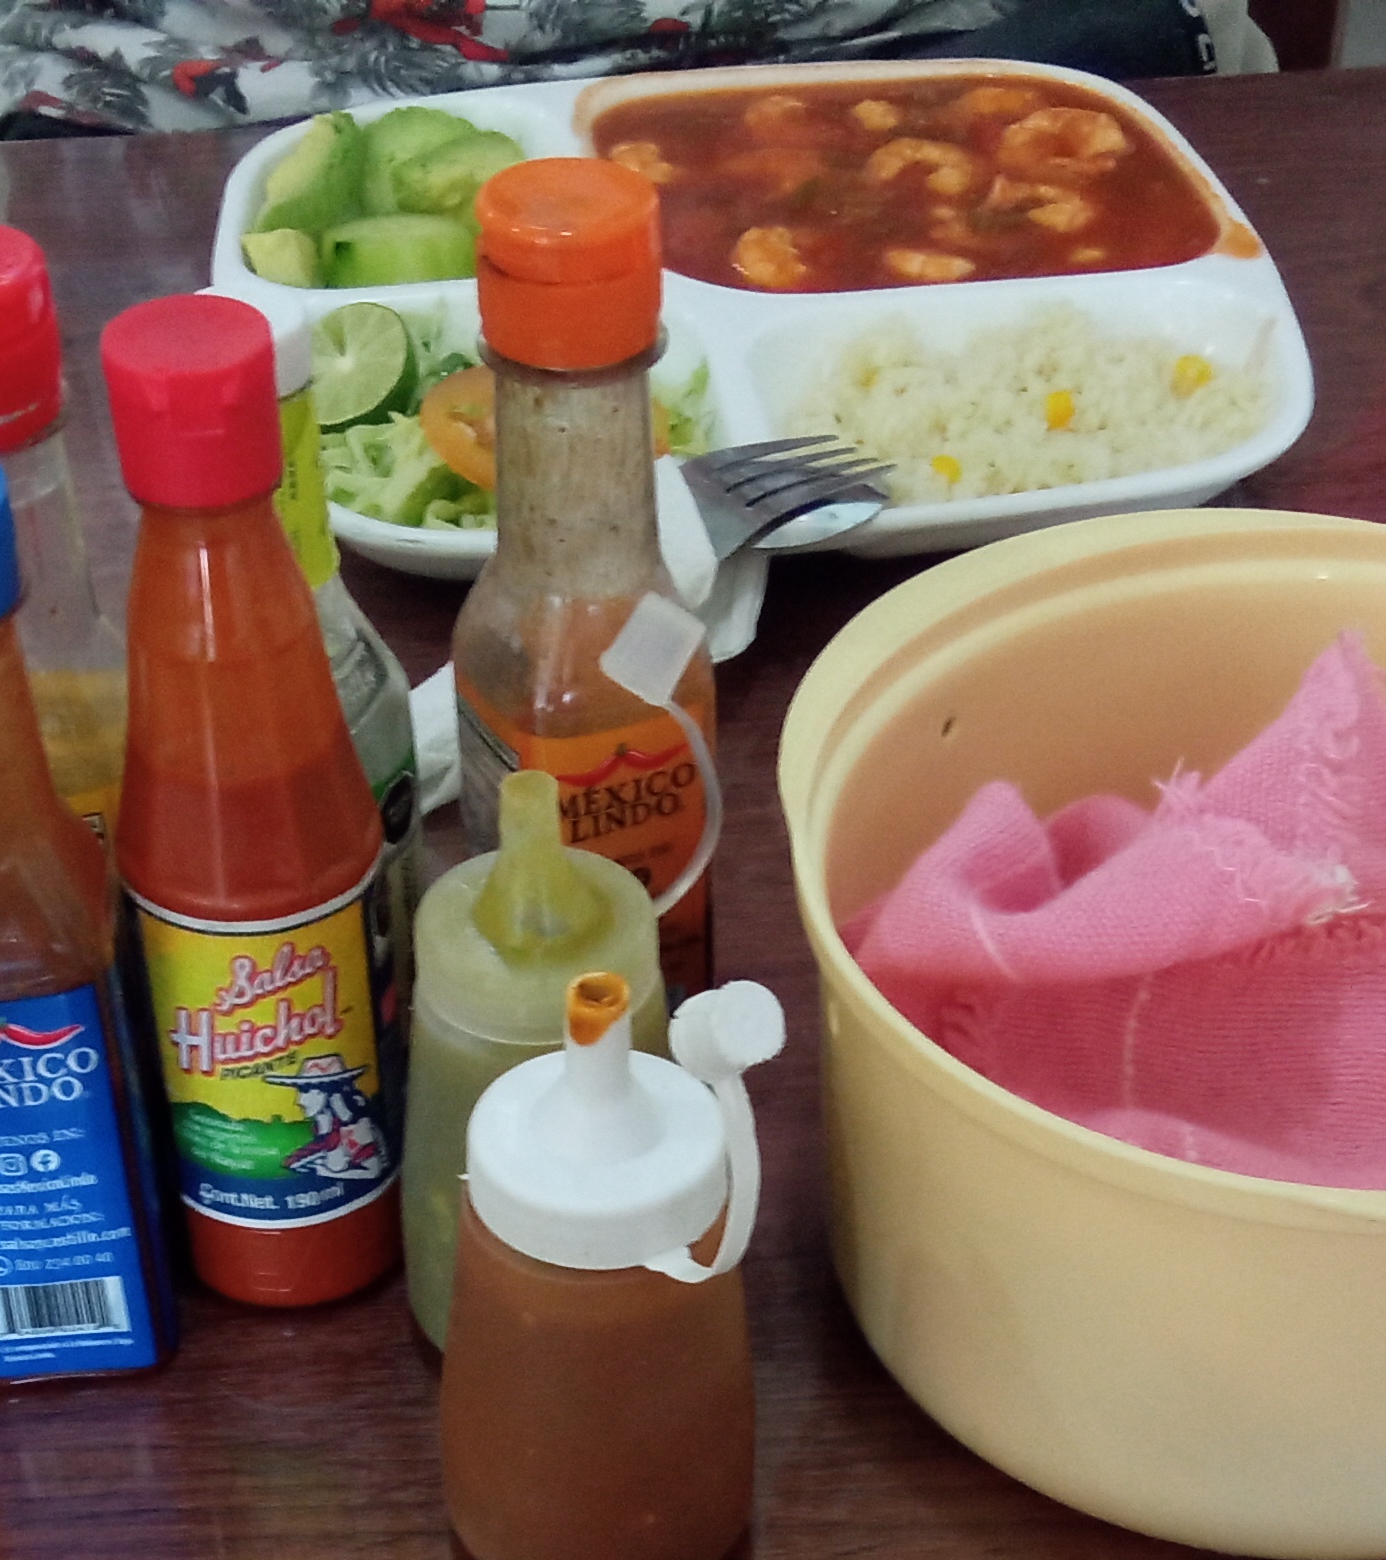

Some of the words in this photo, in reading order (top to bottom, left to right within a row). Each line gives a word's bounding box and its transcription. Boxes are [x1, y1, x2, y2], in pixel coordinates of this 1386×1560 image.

[571, 793, 679, 844] LINDO
[215, 942, 331, 1016] Salsa
[170, 966, 343, 1077] Huichol
